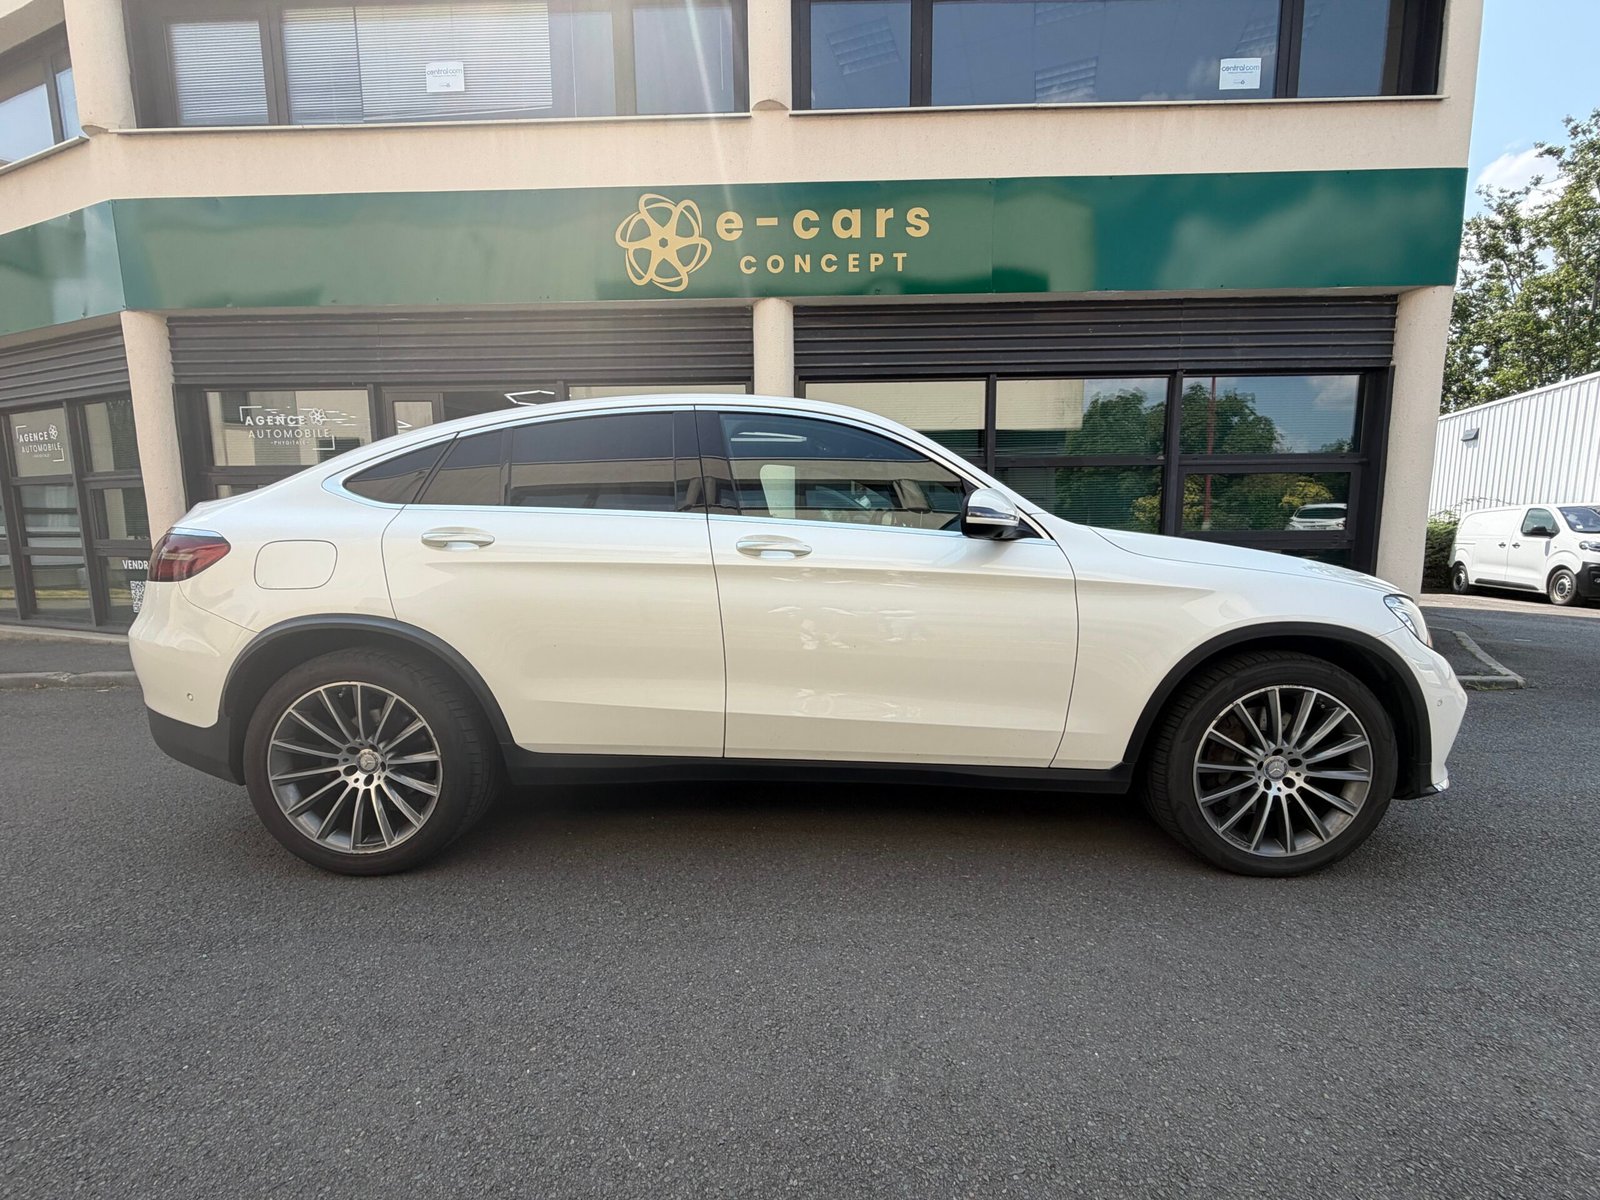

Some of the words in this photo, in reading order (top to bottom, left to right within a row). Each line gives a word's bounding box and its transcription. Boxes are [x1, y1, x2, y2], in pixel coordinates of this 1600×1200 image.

[715, 206, 931, 242] e-cars
[739, 252, 908, 274] CONCEPT
[244, 415, 306, 426] AGENCE
[19, 431, 49, 443] AGENCE
[248, 428, 331, 439] AUTOMOBILE
[21, 442, 61, 453] AUTOMOBILE
[122, 559, 149, 570] VENDR
